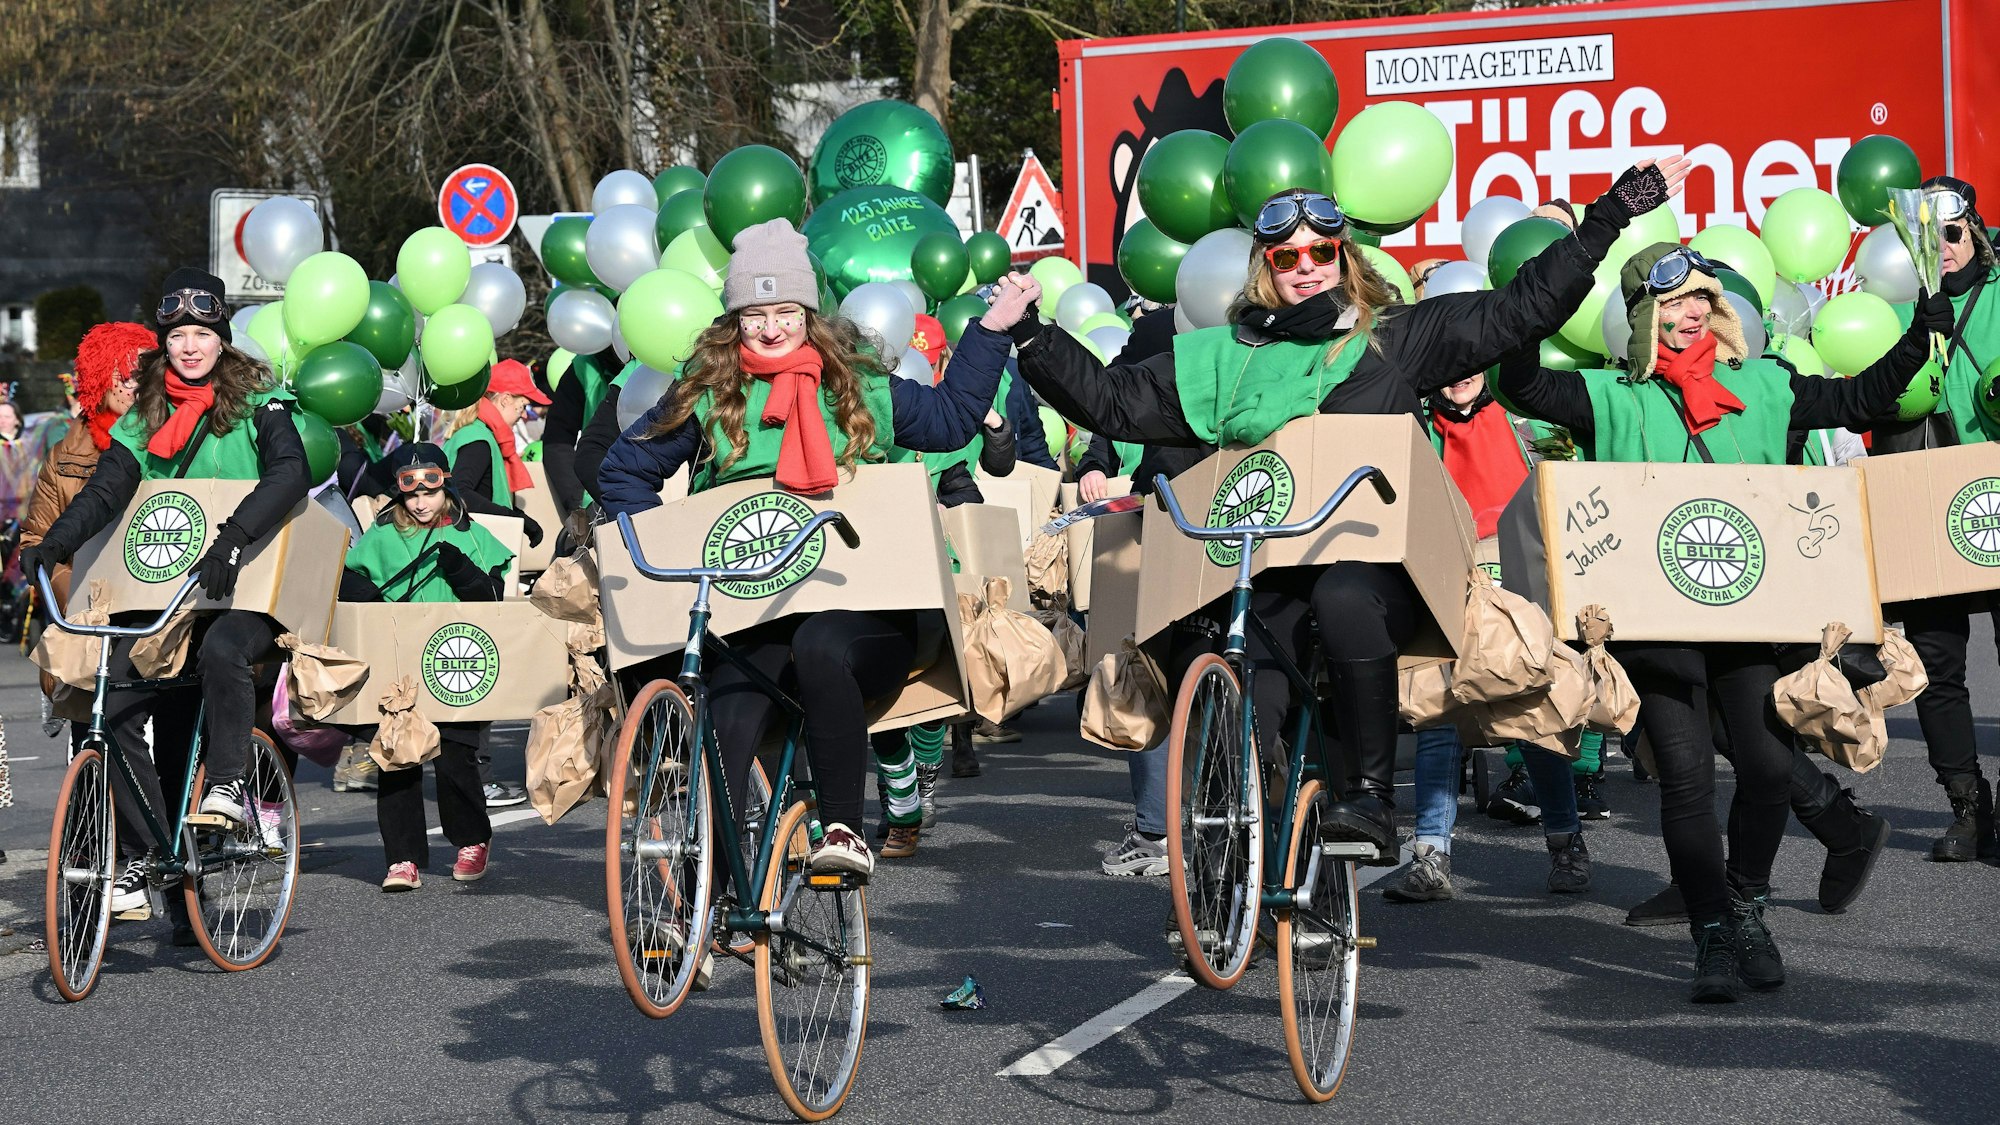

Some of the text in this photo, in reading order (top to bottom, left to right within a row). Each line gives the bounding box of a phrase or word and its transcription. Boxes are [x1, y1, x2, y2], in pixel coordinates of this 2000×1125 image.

[1375, 44, 1604, 86] MONTAGETEAM
[841, 196, 924, 225] 125 JAHRE
[1211, 454, 1289, 516] RADSPORT-VEREIN
[1277, 488, 1289, 508] e.V.
[132, 495, 203, 530] RADSPORT-VEREIN
[1226, 492, 1265, 525] BLITZ
[1566, 485, 1610, 534] 125
[1662, 503, 1758, 543] RADSPORT-VEREIN
[143, 532, 183, 543] BLITZ
[734, 532, 790, 559] BLITZ
[791, 554, 816, 577] 1901
[808, 534, 820, 552] e.V.
[1566, 533, 1622, 576] Jahre
[1686, 545, 1736, 559] BLITZ
[127, 533, 202, 580] HOFFNUNGSTHAL 1901 e.V.
[1662, 548, 1760, 602] HOFFNUNGSTHAL 1901 e.V.
[426, 625, 495, 656] RADSPORT-VEREIN
[424, 661, 496, 704] HOFFNUNGSTHAL 1901 e.V.
[441, 660, 478, 670] BLITZ
